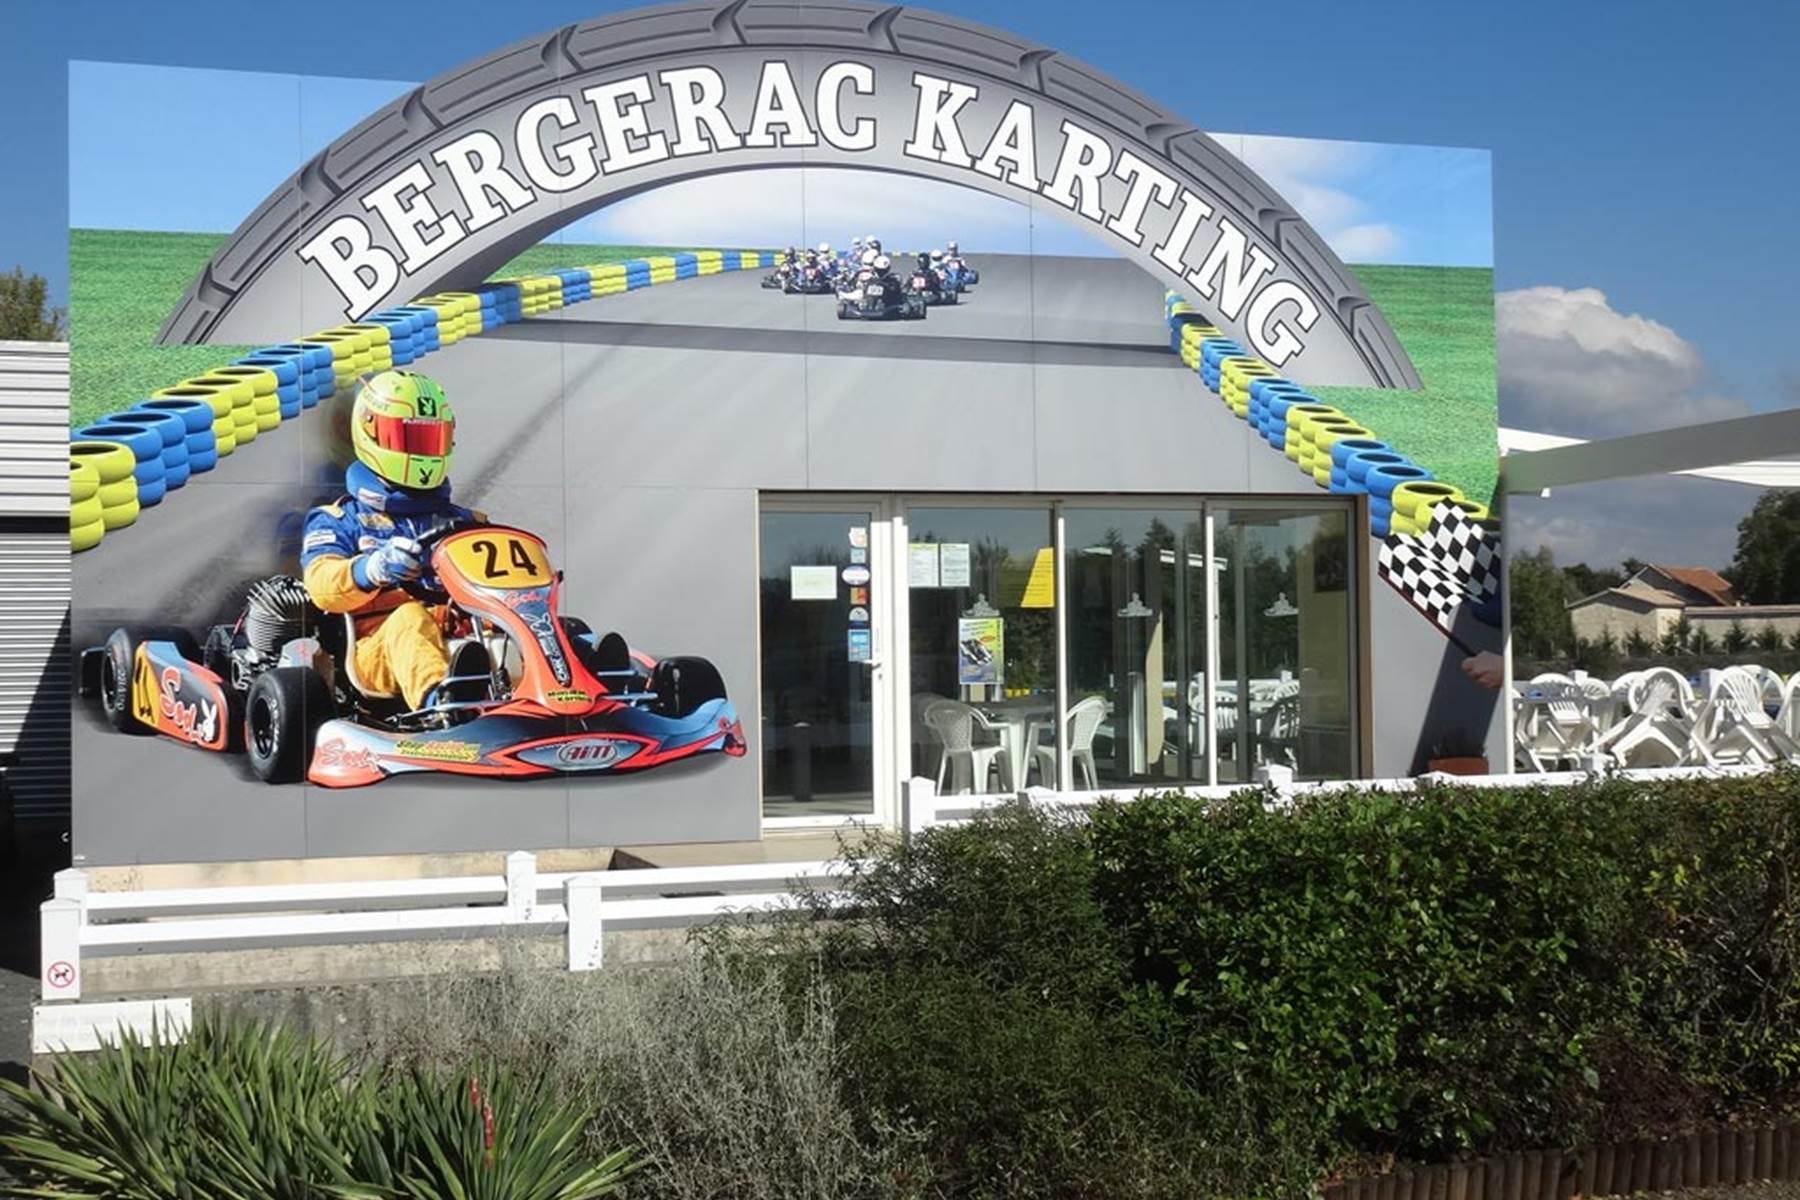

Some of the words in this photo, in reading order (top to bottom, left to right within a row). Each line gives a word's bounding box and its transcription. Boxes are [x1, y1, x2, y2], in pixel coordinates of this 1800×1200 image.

[299, 60, 876, 322] BERGERAC
[904, 72, 1321, 367] KARTING
[472, 539, 538, 579] 24
